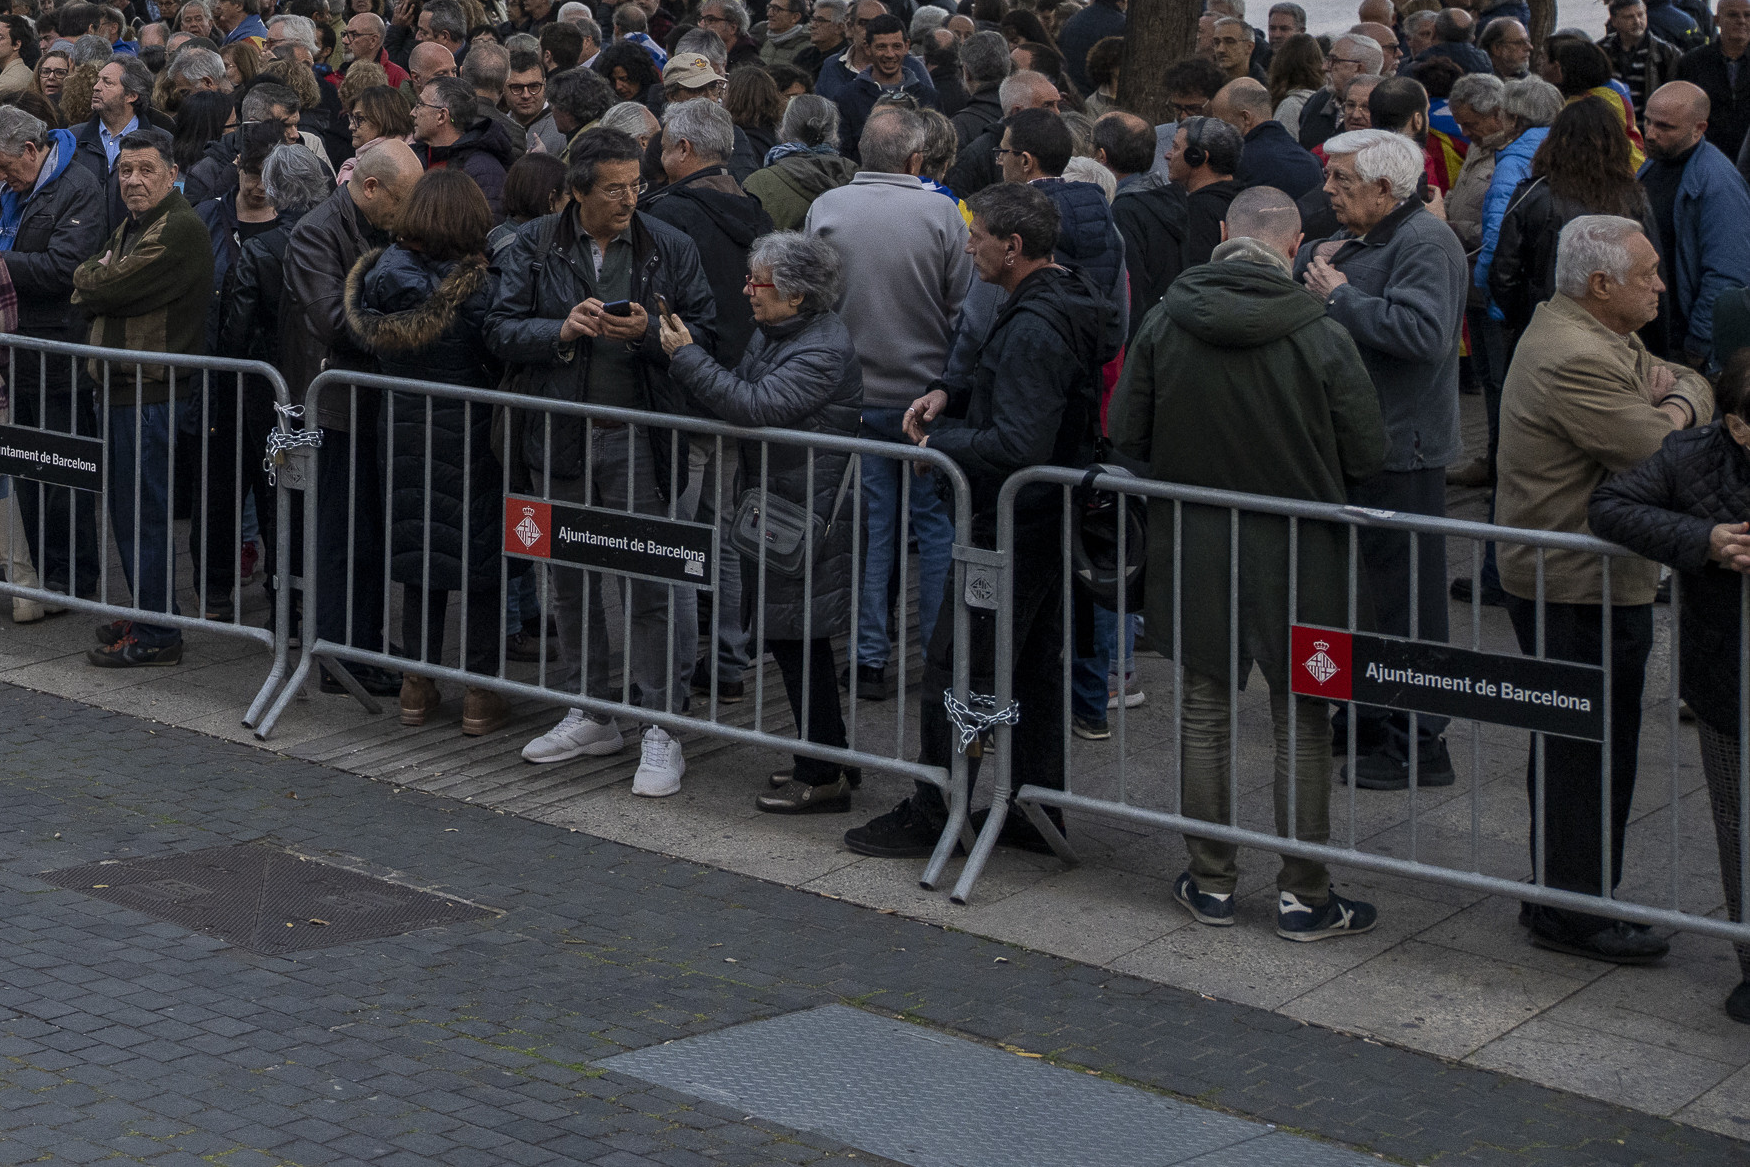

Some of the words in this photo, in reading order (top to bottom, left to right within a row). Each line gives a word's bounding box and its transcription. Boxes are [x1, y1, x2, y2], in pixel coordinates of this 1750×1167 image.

[39, 451, 51, 464] de
[52, 453, 97, 473] Barcelona
[558, 526, 628, 550] Ajuntament
[630, 538, 645, 553] de
[647, 540, 706, 563] Barcelona
[1365, 662, 1472, 694] Ajuntament
[1475, 677, 1497, 698] de
[1500, 682, 1592, 712] Barcelona
